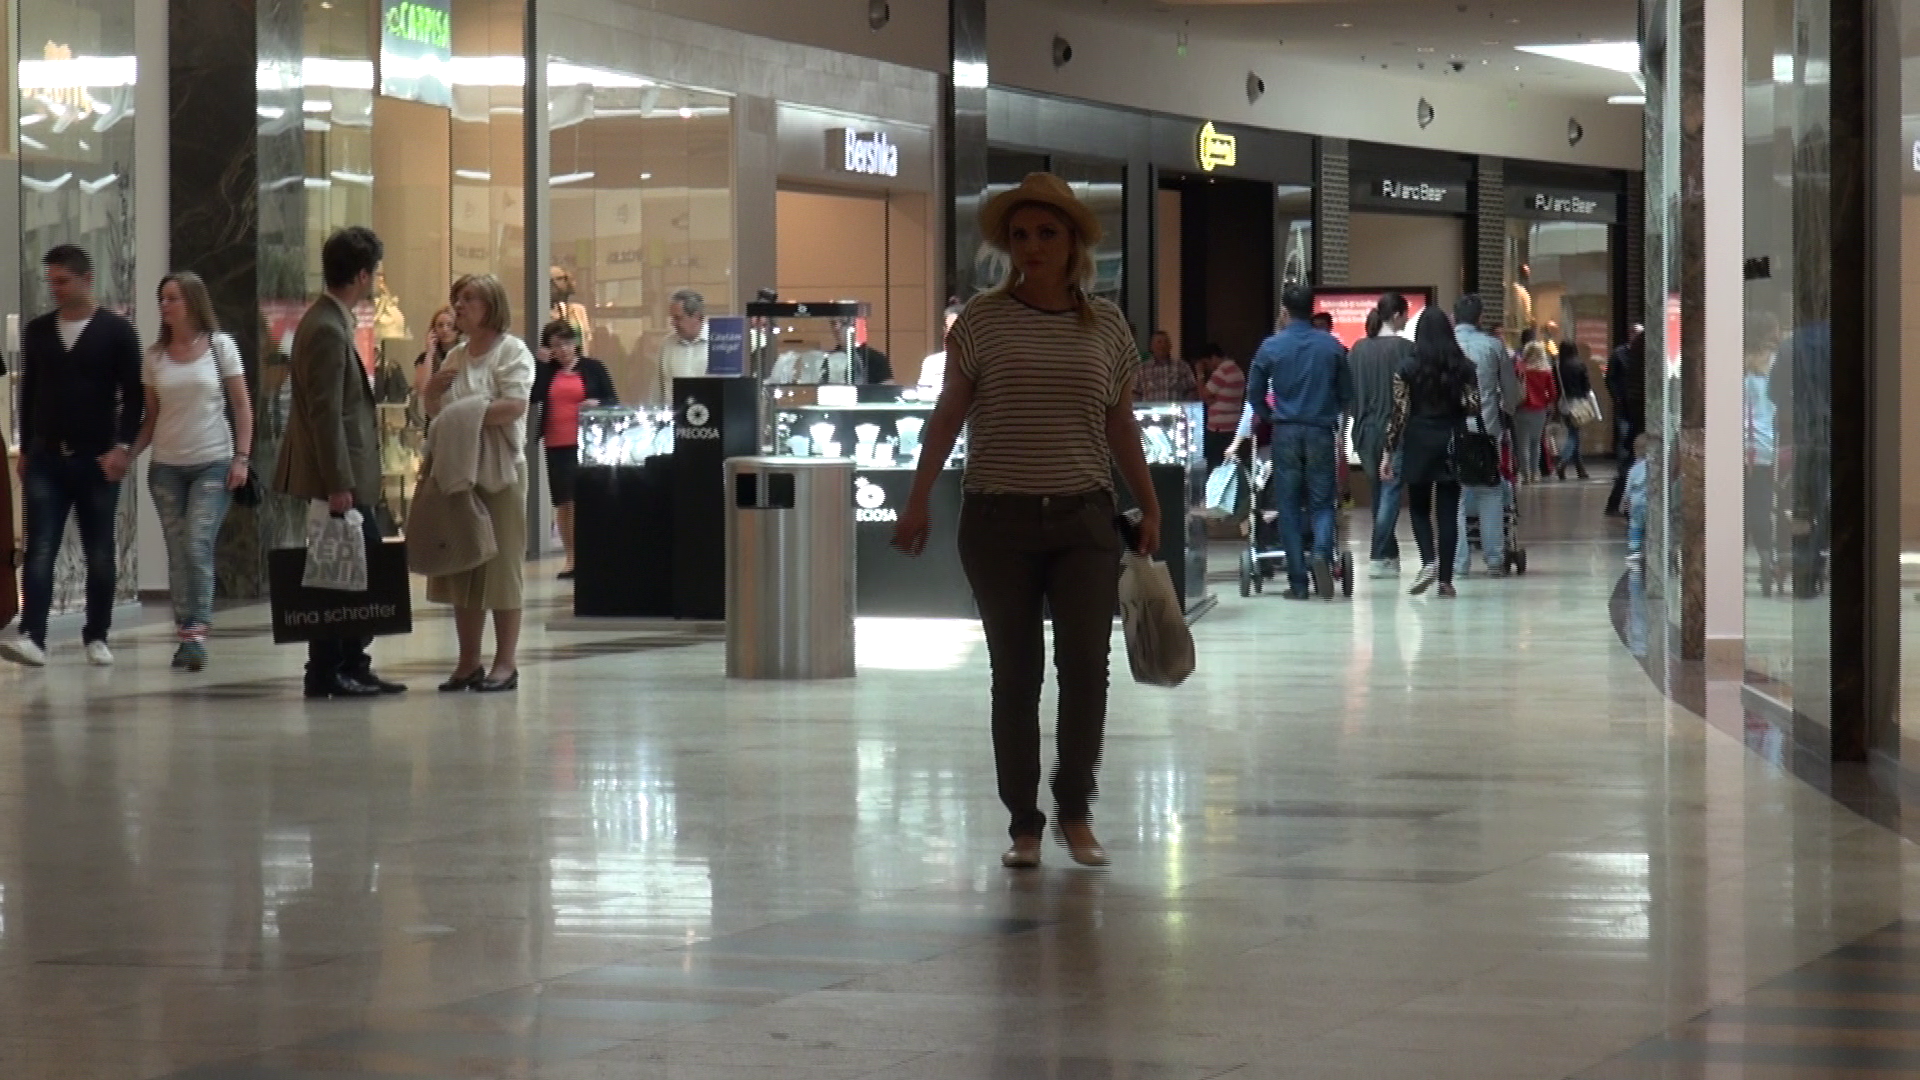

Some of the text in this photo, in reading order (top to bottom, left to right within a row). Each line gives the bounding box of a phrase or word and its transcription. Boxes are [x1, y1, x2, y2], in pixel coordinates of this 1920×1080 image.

[400, 2, 450, 48] CARPISA
[845, 127, 898, 177] Bershka
[1420, 183, 1447, 202] Bear
[1572, 196, 1598, 214] Bear
[675, 427, 720, 440] PRECIOSA
[855, 508, 898, 522] ECIOSA
[323, 603, 397, 624] schrotter
